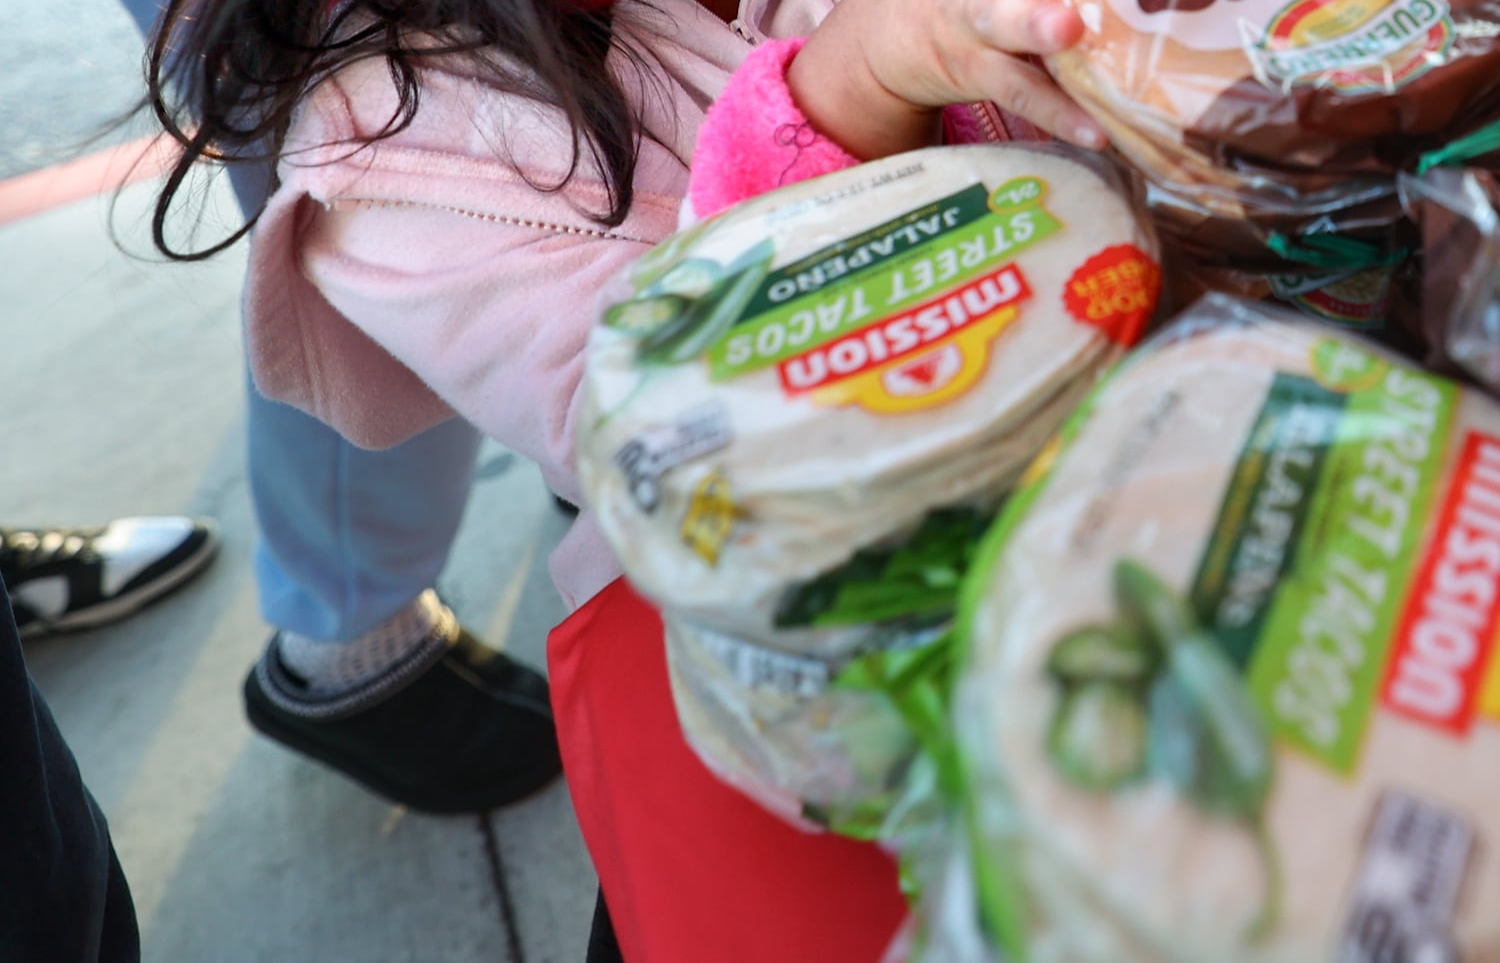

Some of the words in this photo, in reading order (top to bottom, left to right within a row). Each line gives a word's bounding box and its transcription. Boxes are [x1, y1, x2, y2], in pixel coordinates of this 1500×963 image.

[767, 206, 961, 303] JALAPEÑO
[885, 211, 1035, 303] STREET
[725, 293, 873, 367] TACOS
[1273, 558, 1389, 749] TACOS
